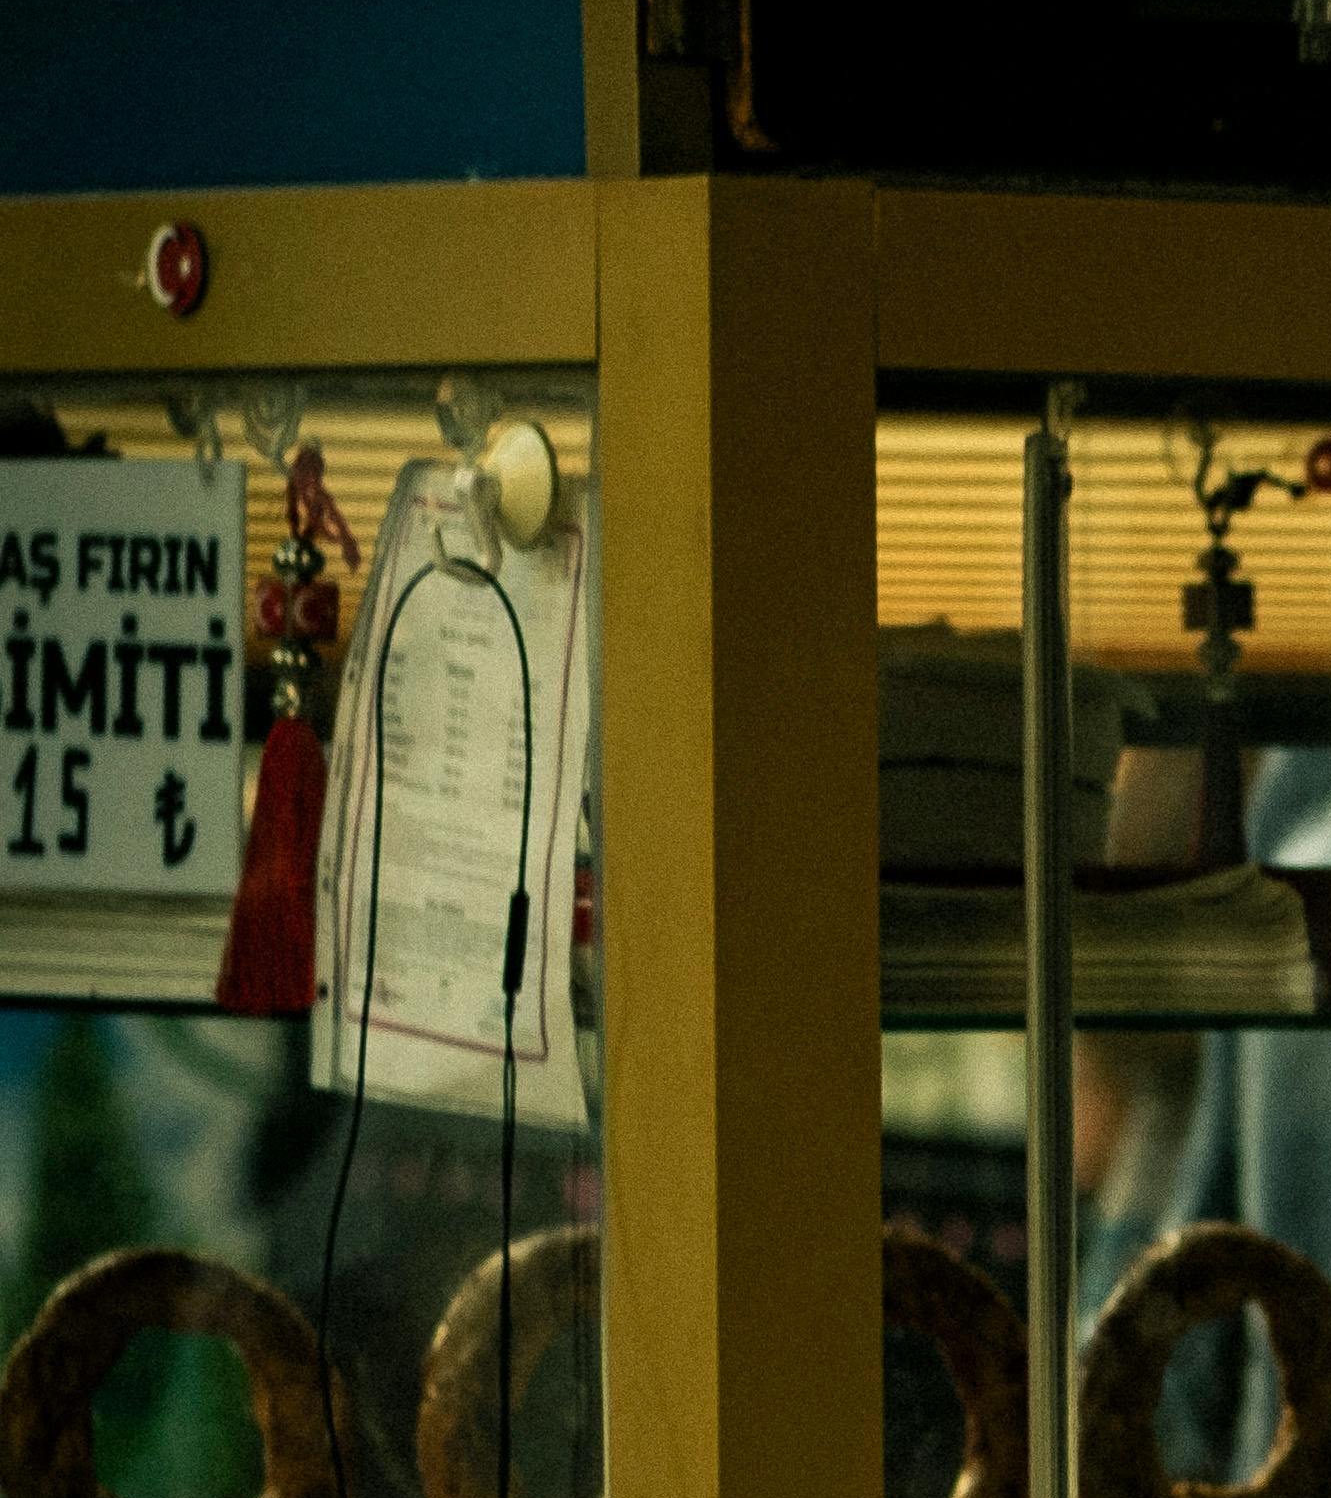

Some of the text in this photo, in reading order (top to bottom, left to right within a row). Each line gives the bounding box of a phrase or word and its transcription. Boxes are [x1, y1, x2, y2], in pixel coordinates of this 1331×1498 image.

[77, 533, 219, 596] FIRIN
[5, 609, 232, 741] İMİTİ
[8, 744, 91, 856] 15
